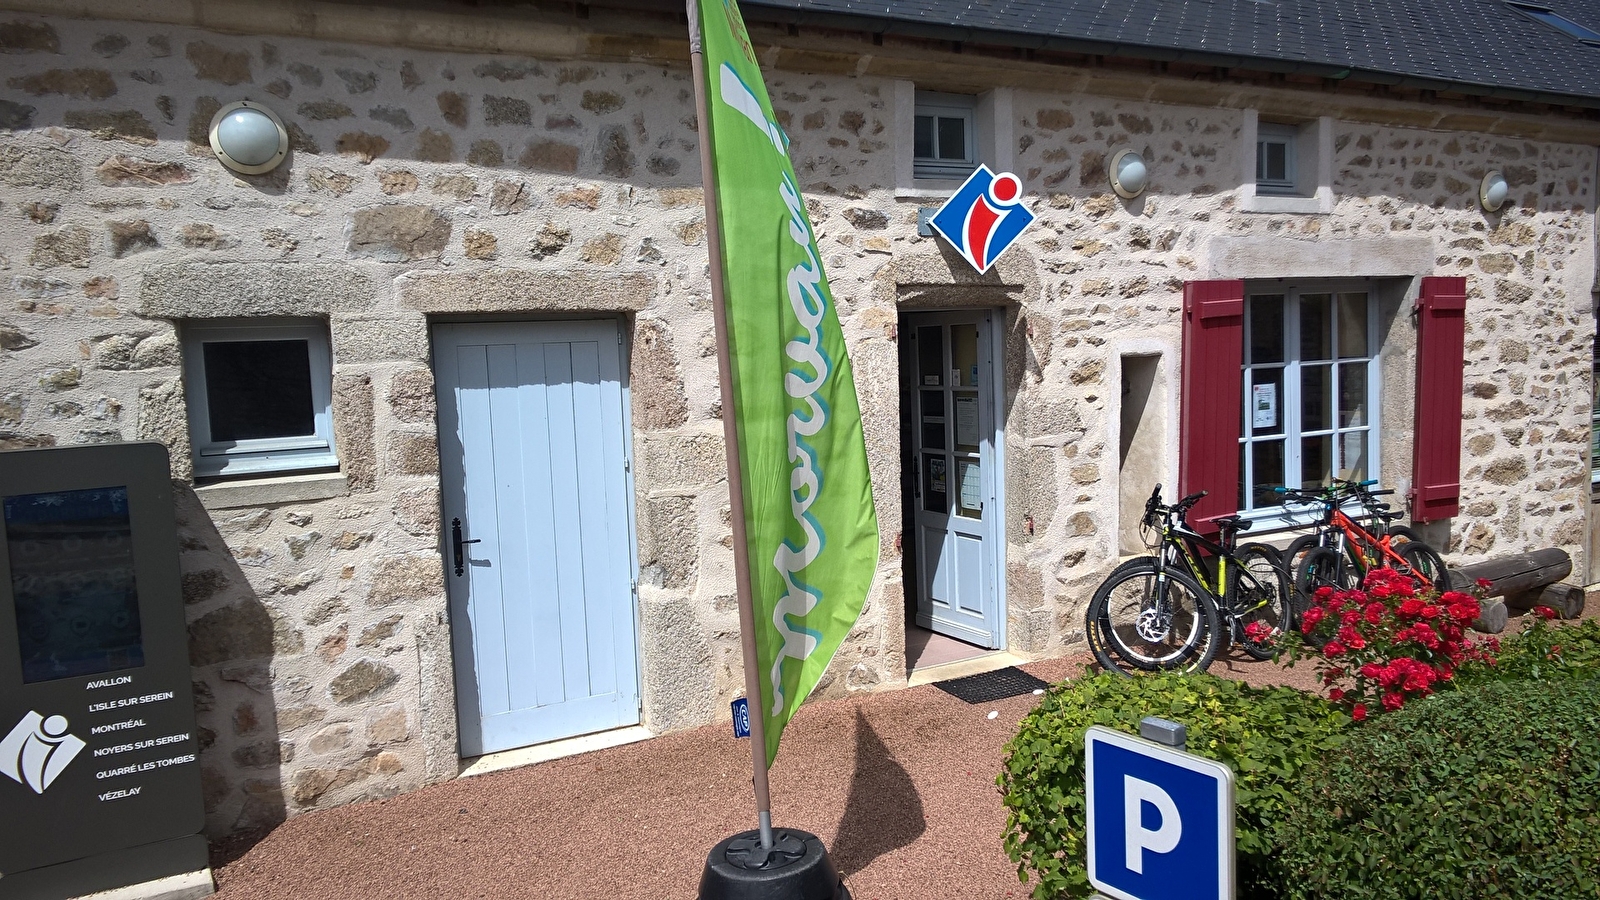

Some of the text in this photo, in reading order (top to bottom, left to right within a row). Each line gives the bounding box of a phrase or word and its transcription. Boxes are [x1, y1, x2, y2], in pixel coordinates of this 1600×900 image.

[86, 675, 132, 690] AVALLON
[88, 691, 174, 712] L'ISLE SUR SEREIN
[91, 718, 146, 735] MONTRÉAL
[93, 733, 190, 757] NOYERS SUR SEREIN
[96, 754, 196, 779] QUARRÉ LES TOMBES
[98, 786, 141, 801] VÉZELAY
[1124, 774, 1182, 875] P
